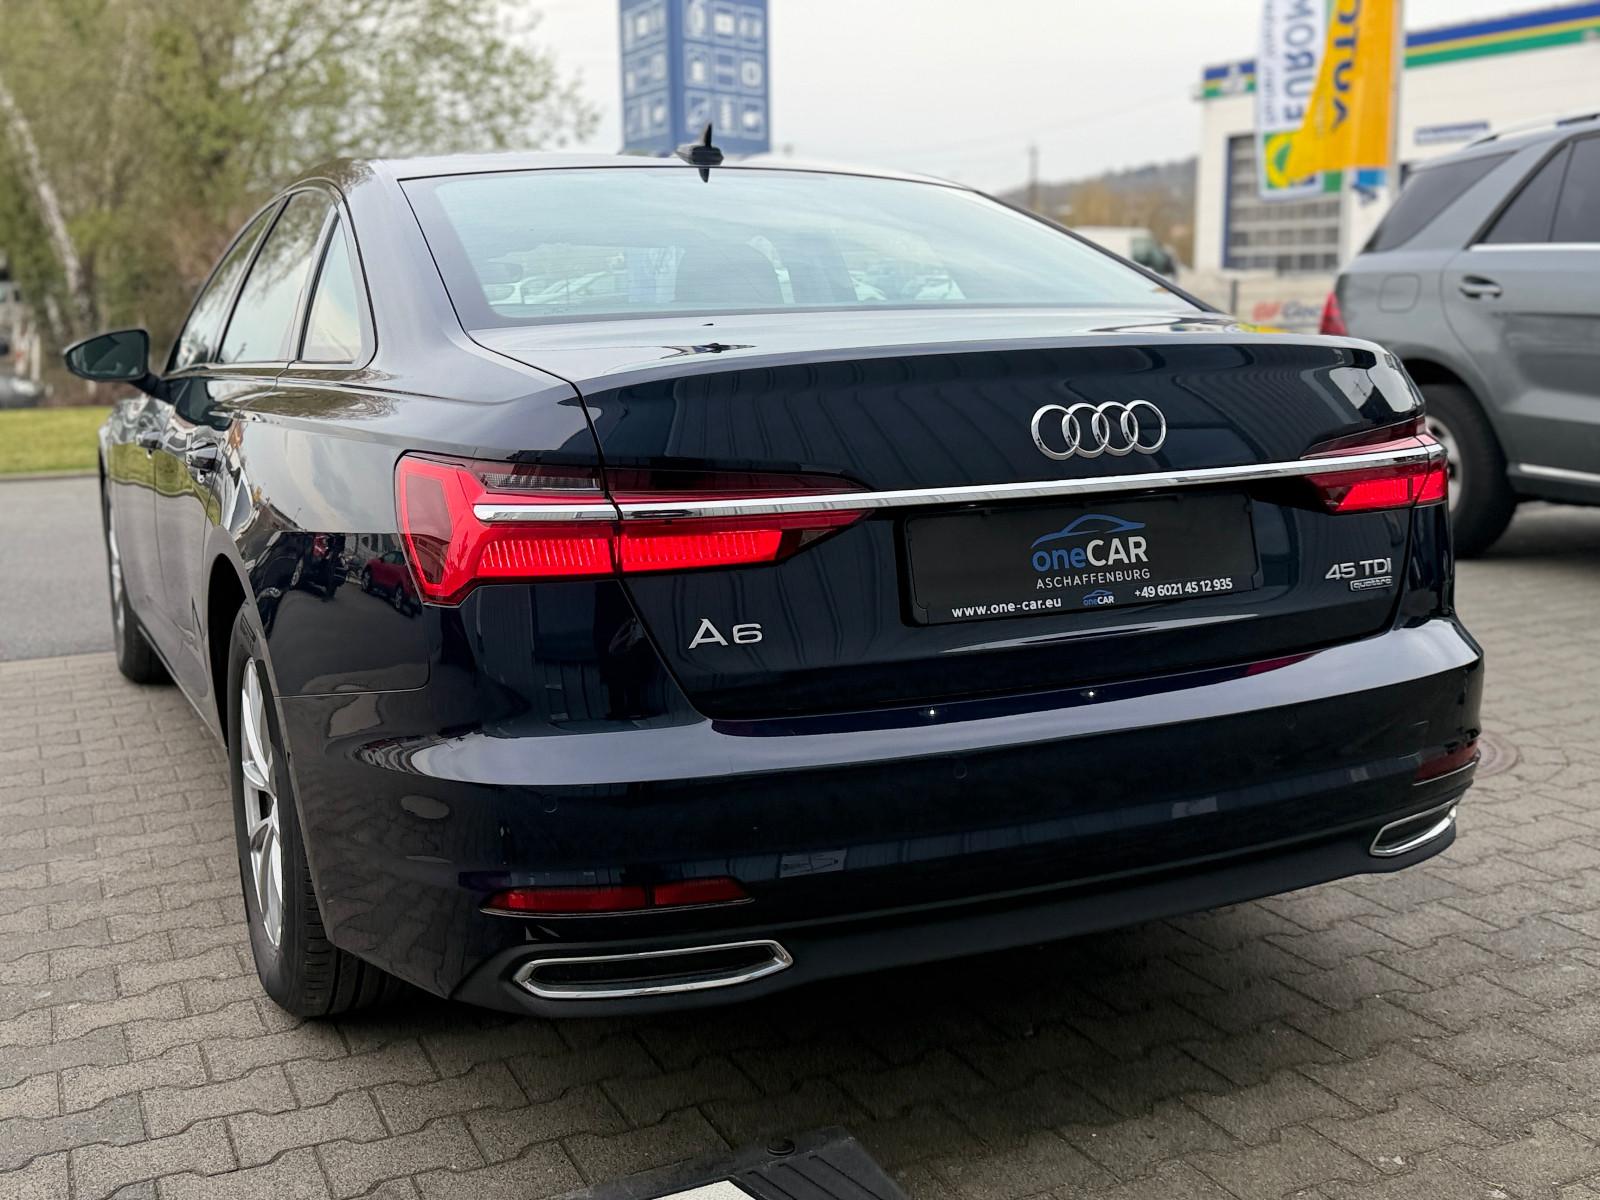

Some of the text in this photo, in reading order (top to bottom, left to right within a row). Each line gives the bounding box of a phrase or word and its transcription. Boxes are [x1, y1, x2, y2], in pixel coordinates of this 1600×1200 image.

[1032, 536, 1149, 572] oneCAR
[1036, 568, 1151, 590] ASCHAFFENBURG
[1325, 557, 1392, 580] 45 TDI
[1134, 577, 1233, 598] +49 6021 45 12 935
[1353, 578, 1392, 589] quattro
[951, 597, 1062, 618] www.one-car.eu
[1083, 595, 1115, 606] oneCAR
[688, 618, 763, 650] A6
